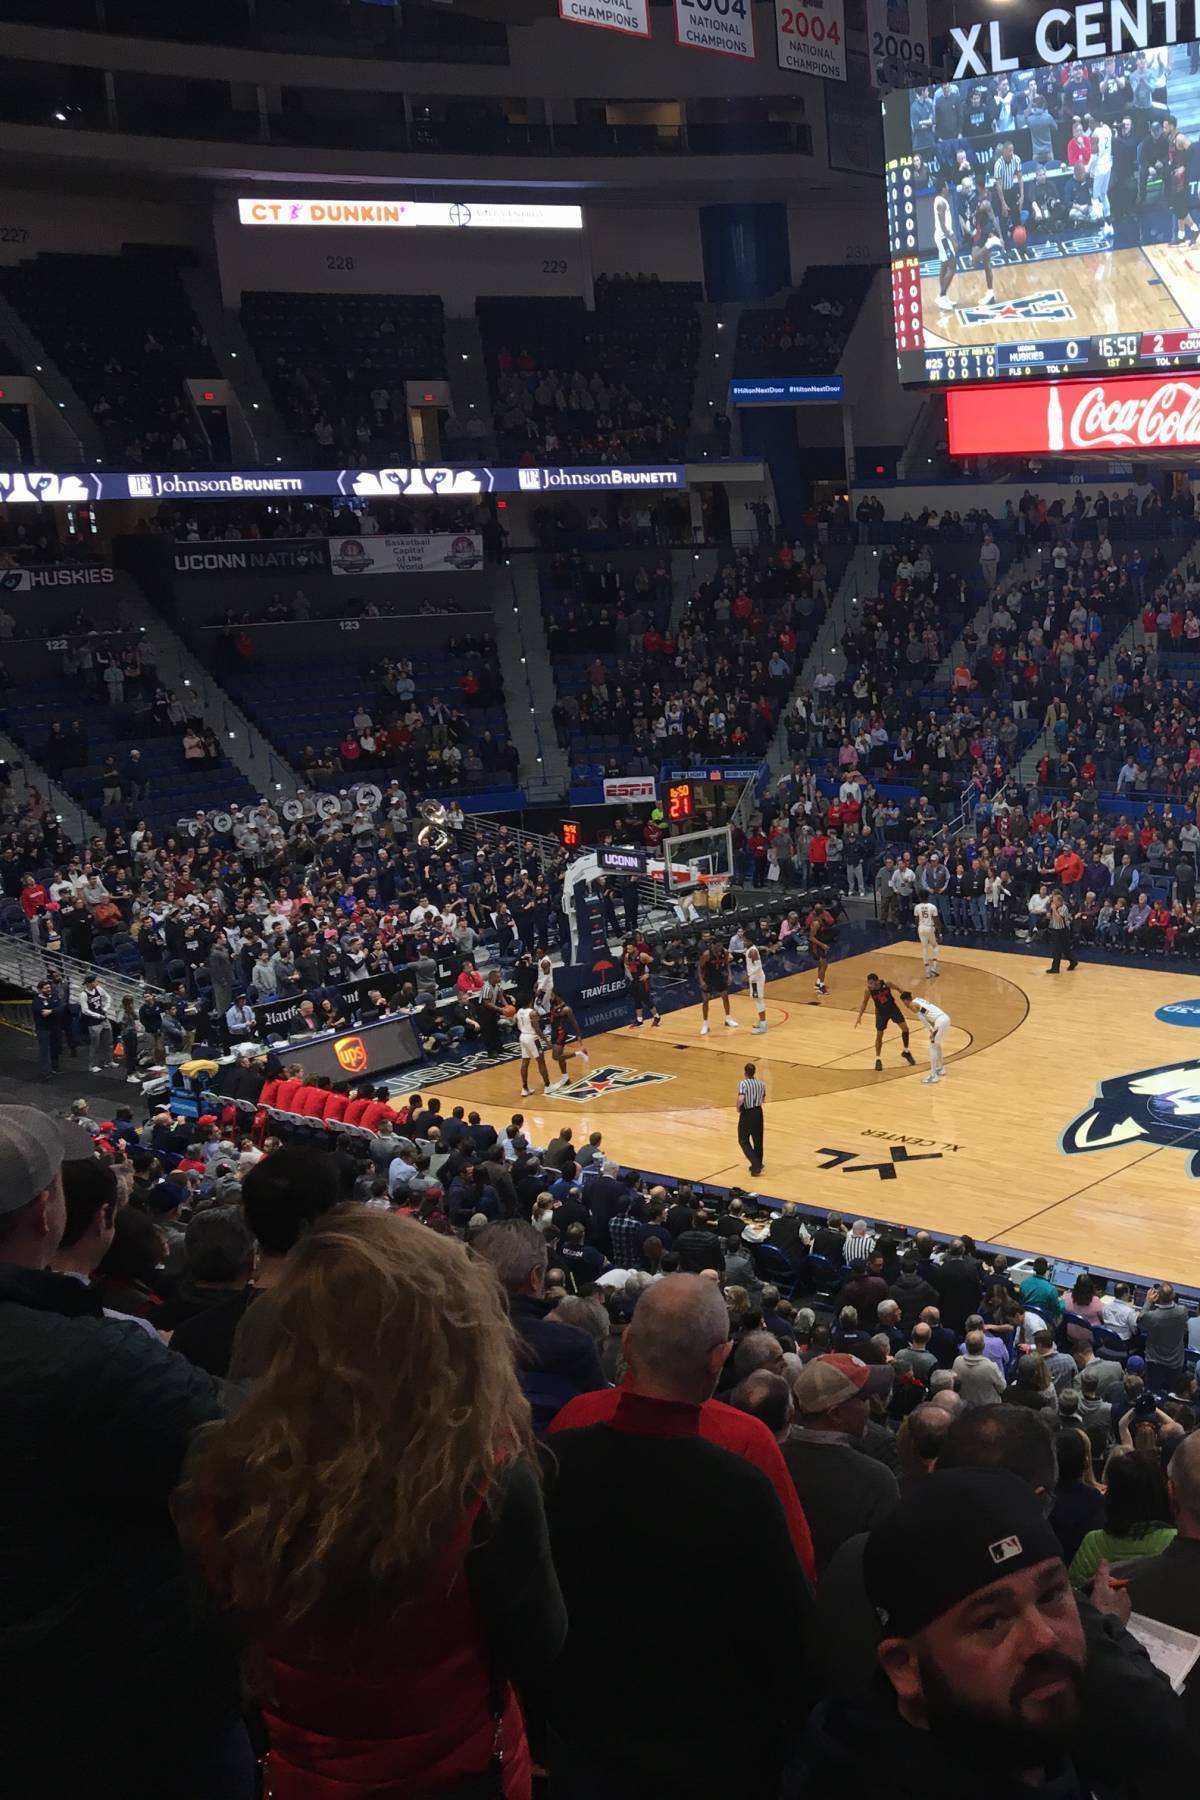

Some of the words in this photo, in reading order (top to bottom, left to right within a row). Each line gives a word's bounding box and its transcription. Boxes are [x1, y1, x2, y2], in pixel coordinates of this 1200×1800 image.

[570, 3, 639, 30] CHAMPIONS
[689, 15, 742, 36] NATIONAL
[781, 8, 841, 45] 2004
[686, 29, 748, 53] CHAMPIONS
[872, 31, 926, 63] 2009
[789, 40, 836, 61] NATIONAL
[950, 22, 1020, 80] XL
[786, 56, 841, 77] CHAMPIONS
[251, 204, 282, 221] CT
[310, 205, 405, 222] DUNKIN'
[327, 255, 354, 271] 228
[542, 259, 568, 274] 229
[1066, 341, 1079, 358] 0
[1098, 336, 1137, 357] 16:50
[1153, 335, 1164, 352] 2
[1047, 365, 1060, 374] TOL
[1062, 365, 1069, 373] 4
[1107, 359, 1120, 368] 1ST
[1156, 358, 1170, 366] TOL
[1173, 357, 1179, 365] 4
[1009, 368, 1023, 376] FLS
[175, 553, 246, 571] UCONN
[30, 568, 114, 587] HUSKIES
[339, 621, 360, 631] 123
[46, 640, 68, 651] 122
[606, 783, 654, 797] ESPN
[670, 798, 690, 819] 21
[564, 833, 576, 844] 21
[604, 854, 638, 867] UCONN
[581, 980, 627, 1000] TRAVELERS
[341, 1044, 365, 1067] ups
[861, 1129, 936, 1147] CENTER
